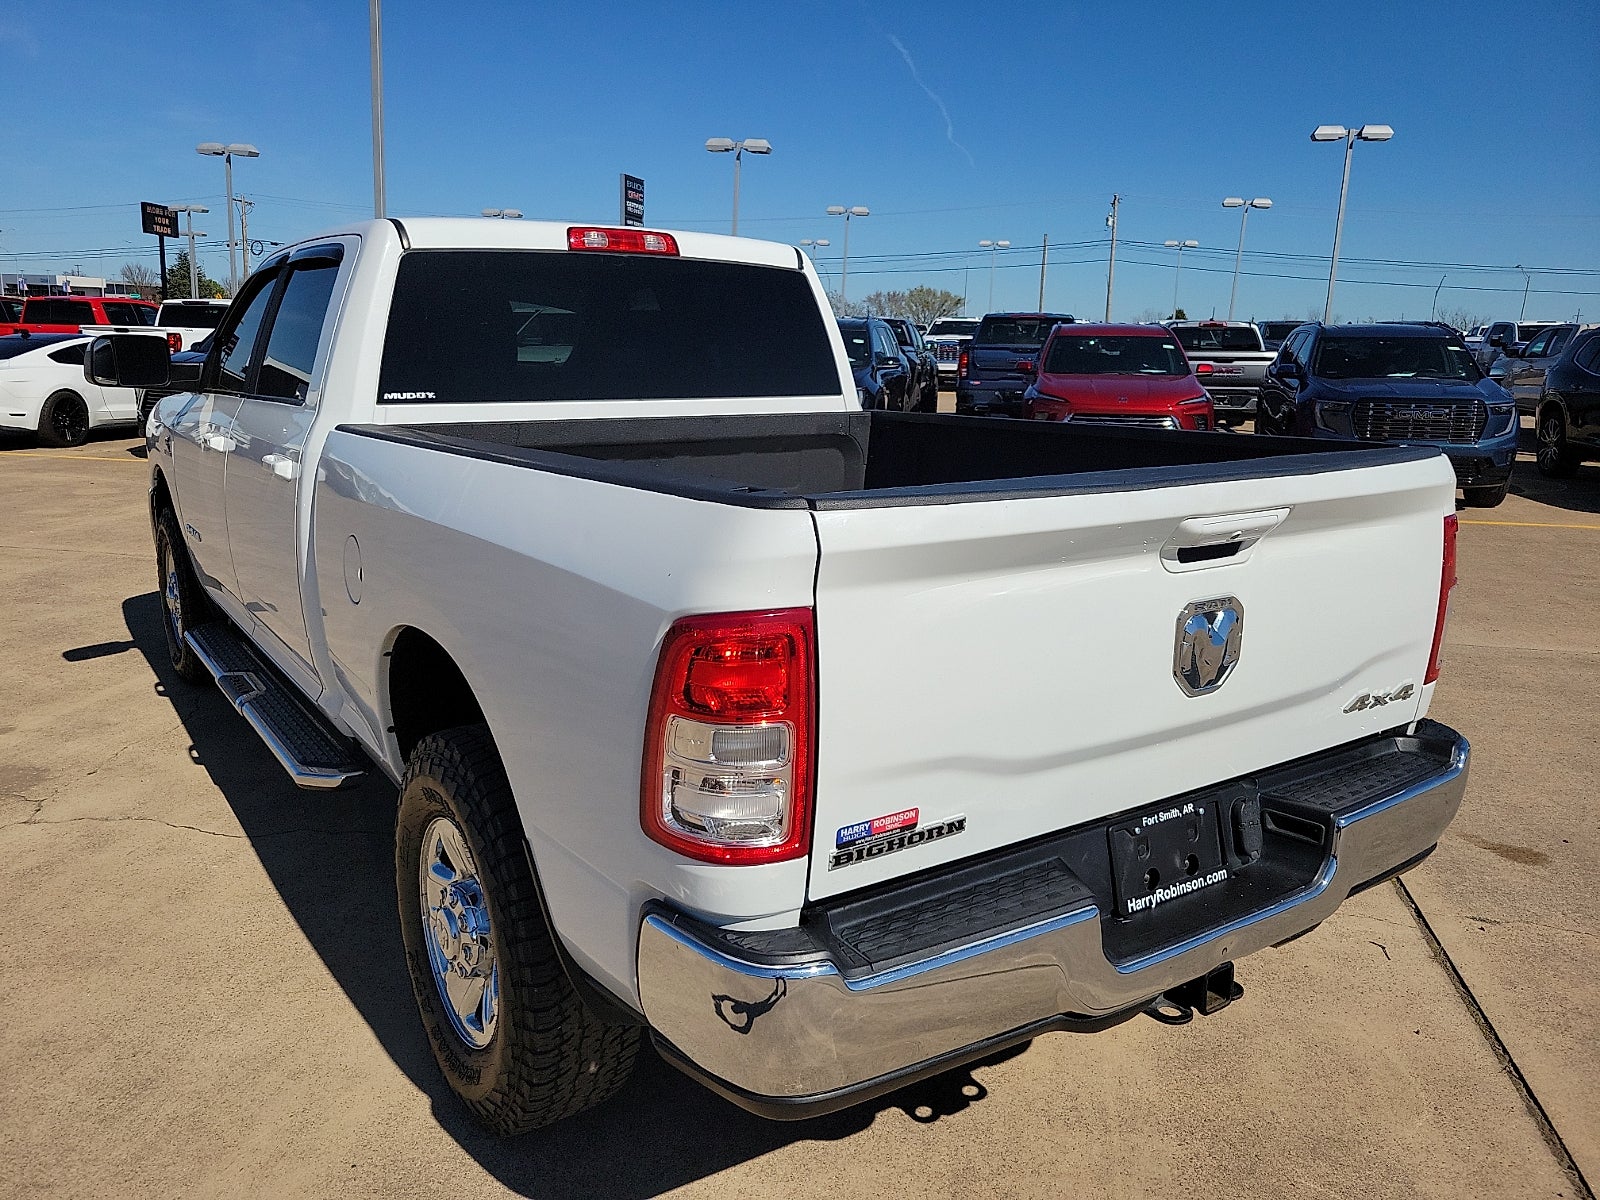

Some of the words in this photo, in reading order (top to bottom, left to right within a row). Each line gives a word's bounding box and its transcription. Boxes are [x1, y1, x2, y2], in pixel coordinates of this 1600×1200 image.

[146, 205, 163, 215] MORE
[164, 209, 176, 218] FOR
[155, 217, 169, 225] YOUR
[153, 224, 172, 234] TRADE
[1398, 410, 1445, 420] GMC
[1343, 683, 1415, 714] 4x4
[840, 822, 870, 838] HARRY
[873, 809, 917, 828] ROBINSON
[1142, 815, 1158, 827] Fort
[1159, 807, 1182, 822] Smith,
[1182, 802, 1195, 815] AR
[828, 816, 966, 872] BIGHORN
[1126, 868, 1228, 913] HarryRobinson.com
